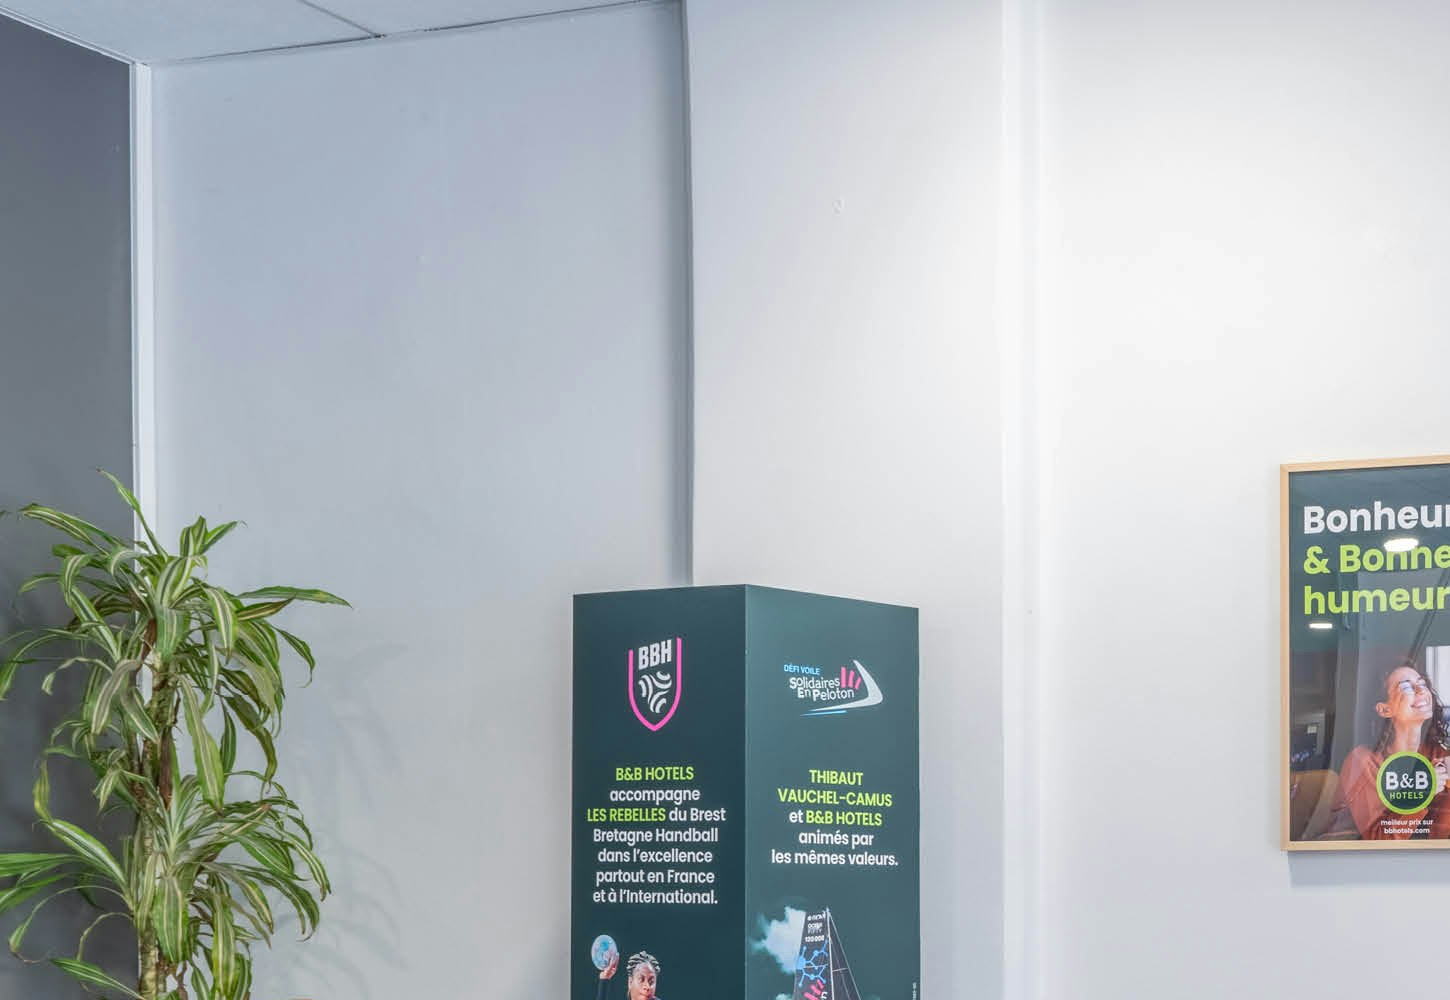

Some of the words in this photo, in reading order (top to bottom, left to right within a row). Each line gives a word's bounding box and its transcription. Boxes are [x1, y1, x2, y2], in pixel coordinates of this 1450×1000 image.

[1304, 546, 1330, 575] &
[639, 640, 672, 670] BBH
[801, 666, 820, 675] VOILE
[797, 687, 812, 699] En
[813, 688, 854, 701] Peloton
[616, 767, 642, 781] B&B
[645, 766, 694, 780] HOTELS
[809, 770, 863, 785] THIBAUT
[1386, 771, 1428, 790] B&B
[610, 788, 701, 804] accompagne
[778, 789, 892, 807] VAUCHEL-CAMUS
[1390, 792, 1424, 800] HOTELS
[587, 808, 606, 822] LES
[610, 808, 666, 822] REBELLES
[669, 808, 686, 821] du
[691, 808, 726, 821] Brest
[789, 810, 802, 823] et
[806, 810, 832, 825] B&B
[836, 812, 882, 826] HOTELS
[1409, 819, 1423, 828] prix
[594, 829, 653, 846] Bretagne
[656, 828, 718, 843] Handball
[799, 831, 849, 845] animés
[852, 833, 874, 848] par
[598, 849, 629, 863] dans
[772, 849, 791, 864] les
[794, 849, 845, 865] mêmes
[848, 852, 898, 866] valeurs.
[596, 869, 644, 886] partout
[648, 872, 664, 883] en
[668, 870, 715, 884] France
[593, 890, 605, 903] et
[608, 889, 616, 903] à
